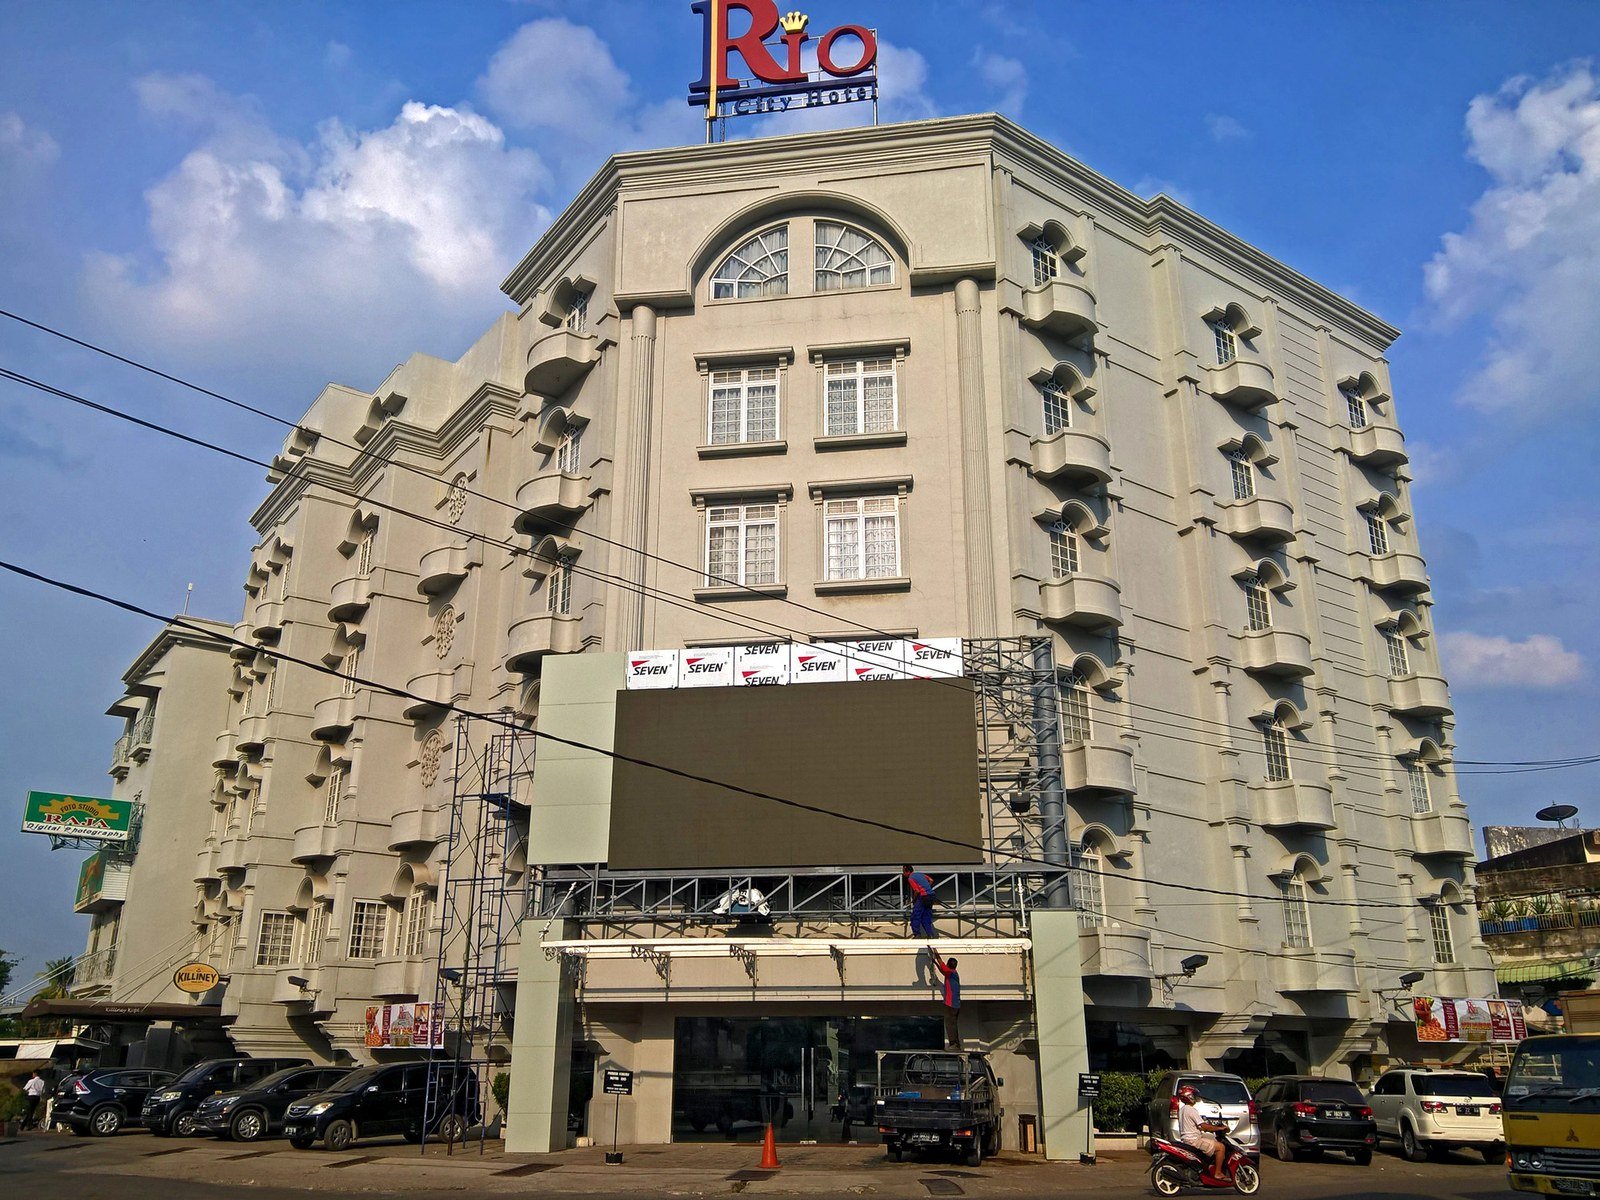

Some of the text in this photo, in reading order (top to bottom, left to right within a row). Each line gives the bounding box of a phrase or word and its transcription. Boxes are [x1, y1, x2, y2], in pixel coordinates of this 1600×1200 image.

[688, 0, 877, 93] Rio
[735, 82, 878, 113] City Hotel
[744, 645, 780, 655] SEVEN
[857, 641, 893, 652] SEVEN
[915, 650, 951, 660] SEVEN
[633, 665, 668, 676] SEVEN
[688, 663, 723, 673] SEVEN
[800, 661, 836, 672] SEVEN
[745, 676, 780, 686] SEVEN
[60, 803, 100, 817] FOTO STUDIO
[44, 813, 111, 829] RAJA
[27, 822, 125, 838] Digital Photography
[177, 972, 217, 984] KILLINEY
